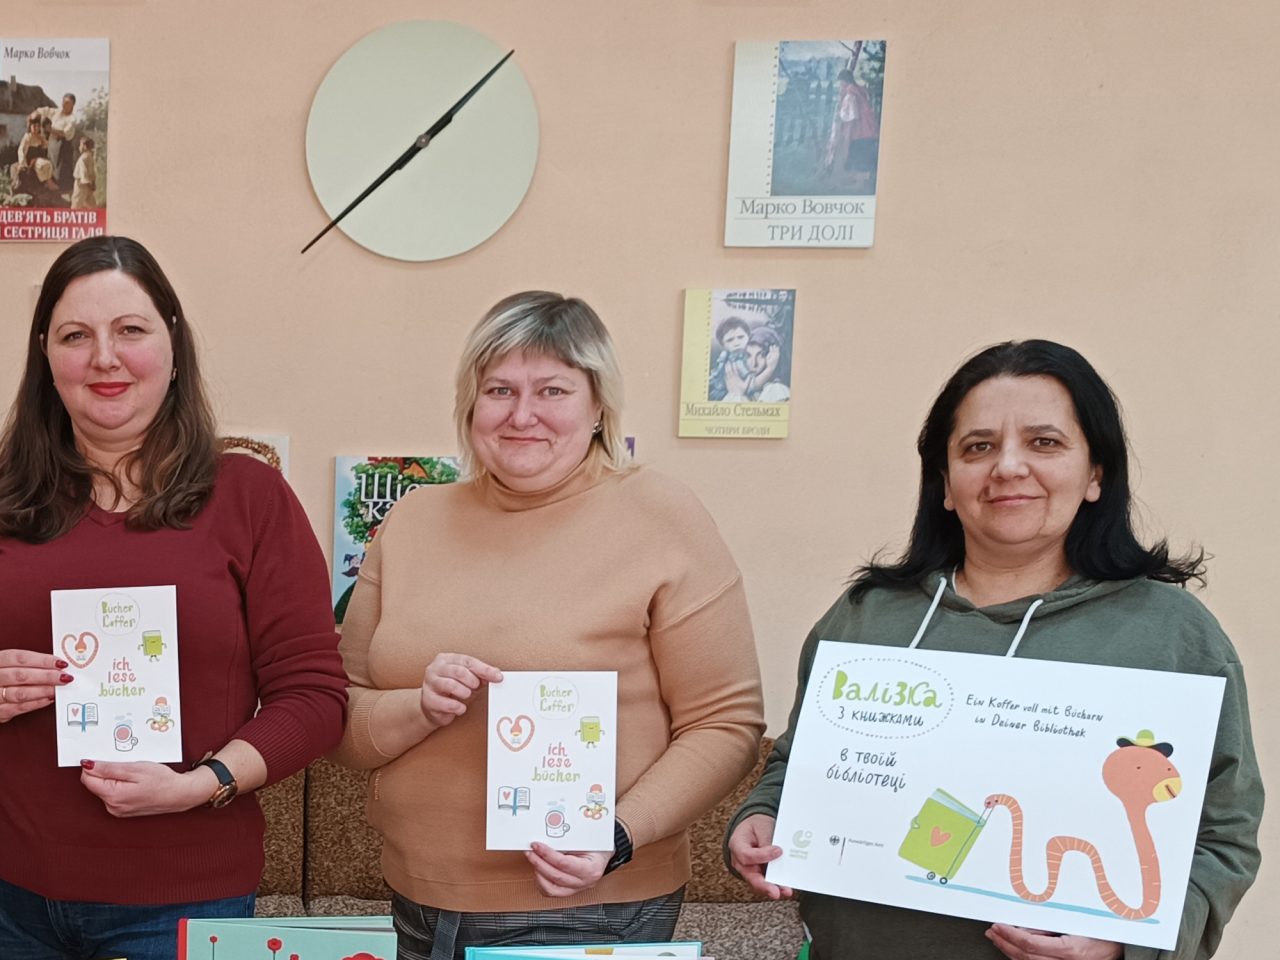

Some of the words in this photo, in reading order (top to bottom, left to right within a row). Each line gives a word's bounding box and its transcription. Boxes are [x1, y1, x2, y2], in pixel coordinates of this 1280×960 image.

[4, 47, 35, 61] Марко
[37, 47, 71, 59] Вовчок
[739, 200, 796, 218] Марко
[801, 200, 864, 214] Вовчок
[54, 210, 97, 224] БРАТІВ
[4, 226, 69, 239] СЕСТРИЦЯ
[767, 224, 802, 240] ТРИ
[808, 224, 854, 242] ДОЛІ
[685, 404, 731, 416] Михайло
[733, 405, 781, 417] Стельмах
[112, 656, 132, 671] ich
[107, 671, 137, 683] lese
[98, 682, 145, 697] bücher
[832, 670, 943, 708] Валізка
[966, 694, 984, 706] Ein
[988, 697, 1020, 711] Koffer
[1023, 703, 1039, 713] voll
[1041, 706, 1060, 716] mit
[851, 709, 924, 727] книжками
[991, 713, 1027, 730] Deiner
[1033, 720, 1086, 738] Bibliothek
[547, 742, 568, 756] ich
[542, 756, 572, 768] lese
[840, 748, 848, 761] в
[856, 751, 897, 767] твоїй
[531, 767, 581, 782] bücher
[826, 763, 906, 793] бібліотеці
